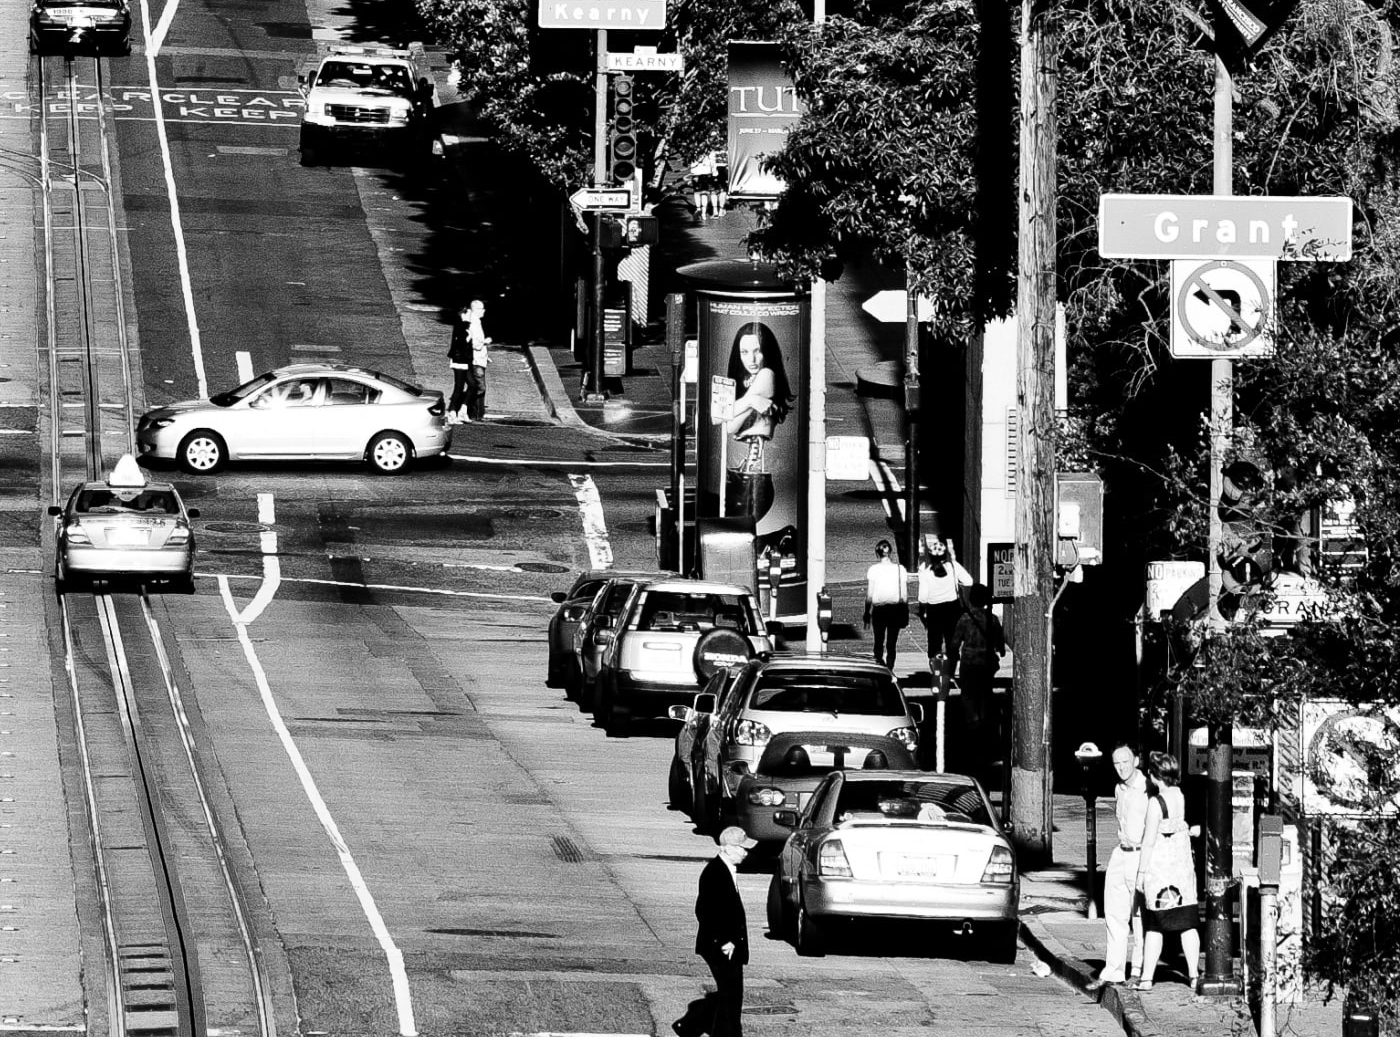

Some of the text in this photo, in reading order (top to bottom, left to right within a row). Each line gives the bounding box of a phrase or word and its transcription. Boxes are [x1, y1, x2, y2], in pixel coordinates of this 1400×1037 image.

[554, 3, 650, 26] Kearny
[614, 56, 678, 68] KEARNY
[163, 93, 306, 108] CLEAR
[730, 86, 801, 113] TUT
[14, 103, 134, 114] KEEP
[179, 106, 298, 120] KEEP
[1153, 210, 1300, 244] Grant
[993, 549, 1007, 563] NO
[1147, 564, 1163, 580] NO
[1263, 600, 1327, 618] GRAN
[704, 651, 749, 663] HONDA
